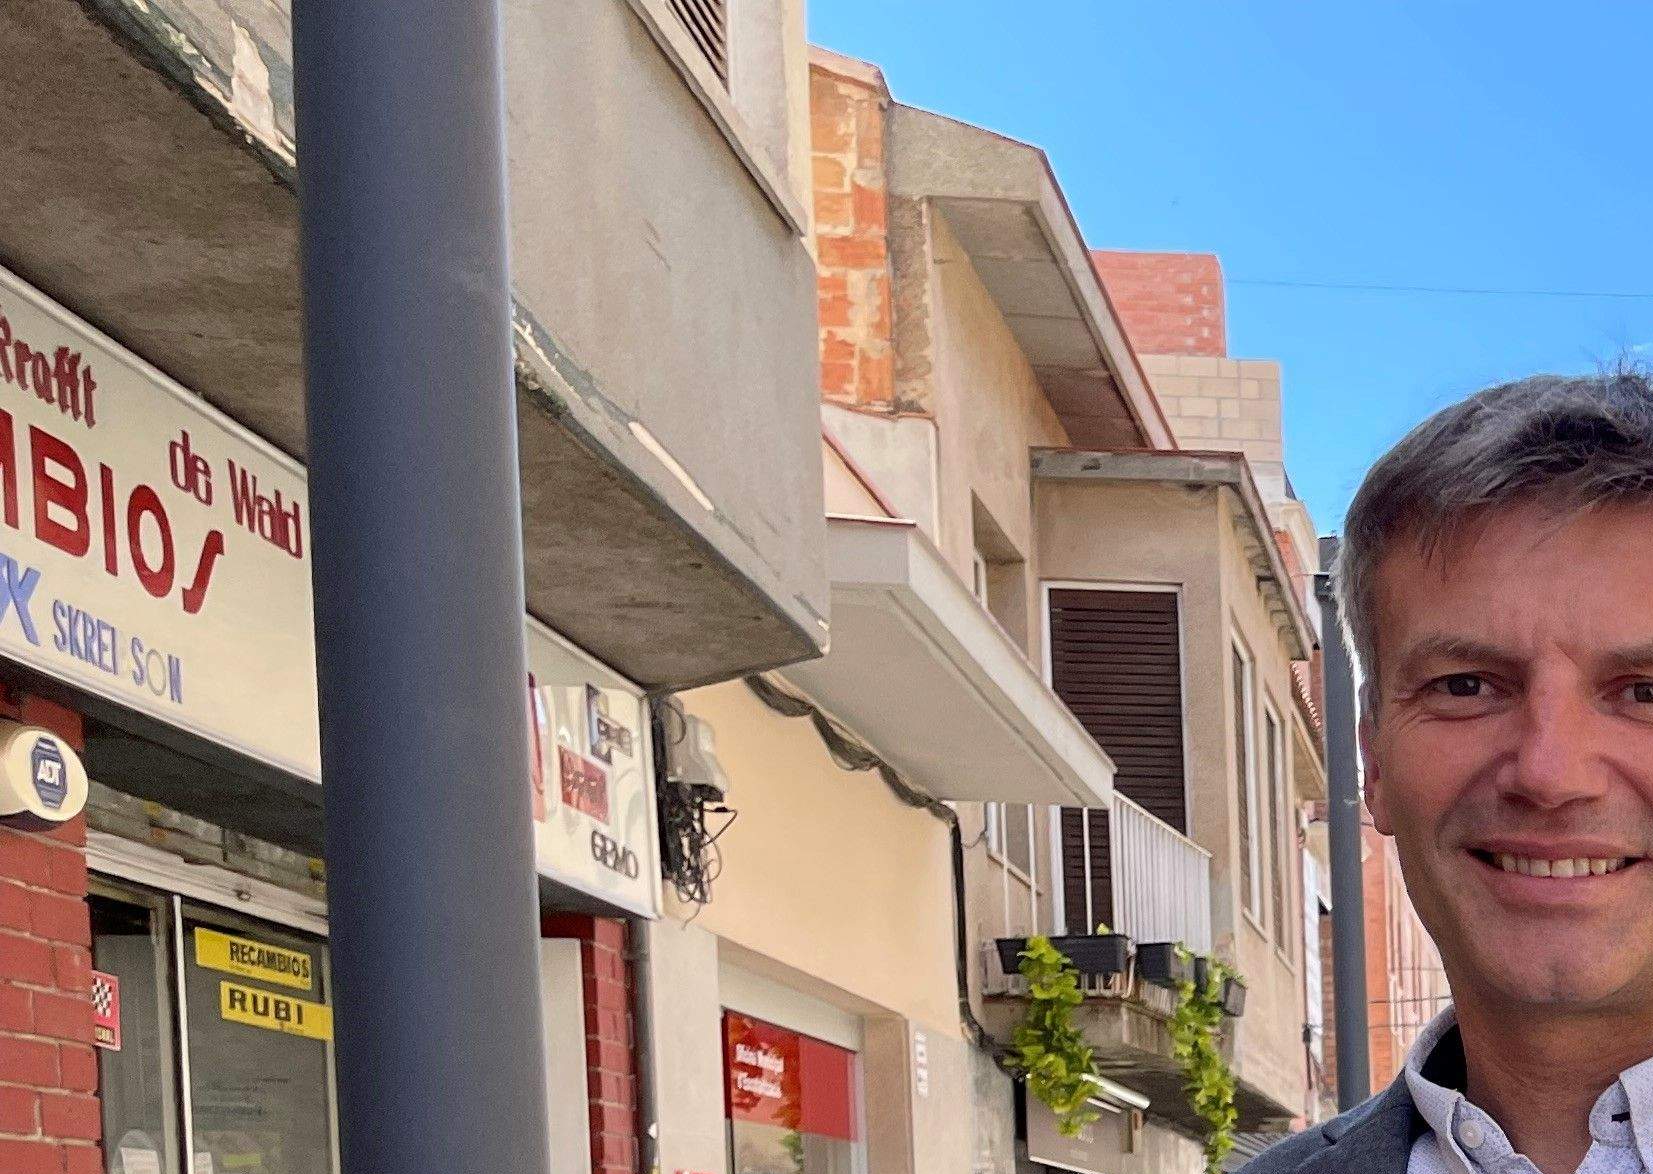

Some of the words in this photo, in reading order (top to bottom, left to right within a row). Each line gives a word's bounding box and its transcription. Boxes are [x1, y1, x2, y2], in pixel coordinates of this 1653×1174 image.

[169, 430, 212, 506] de
[227, 458, 303, 560] Wald
[229, 940, 309, 978] RECAMBIOS
[229, 988, 303, 1025] RUBI
